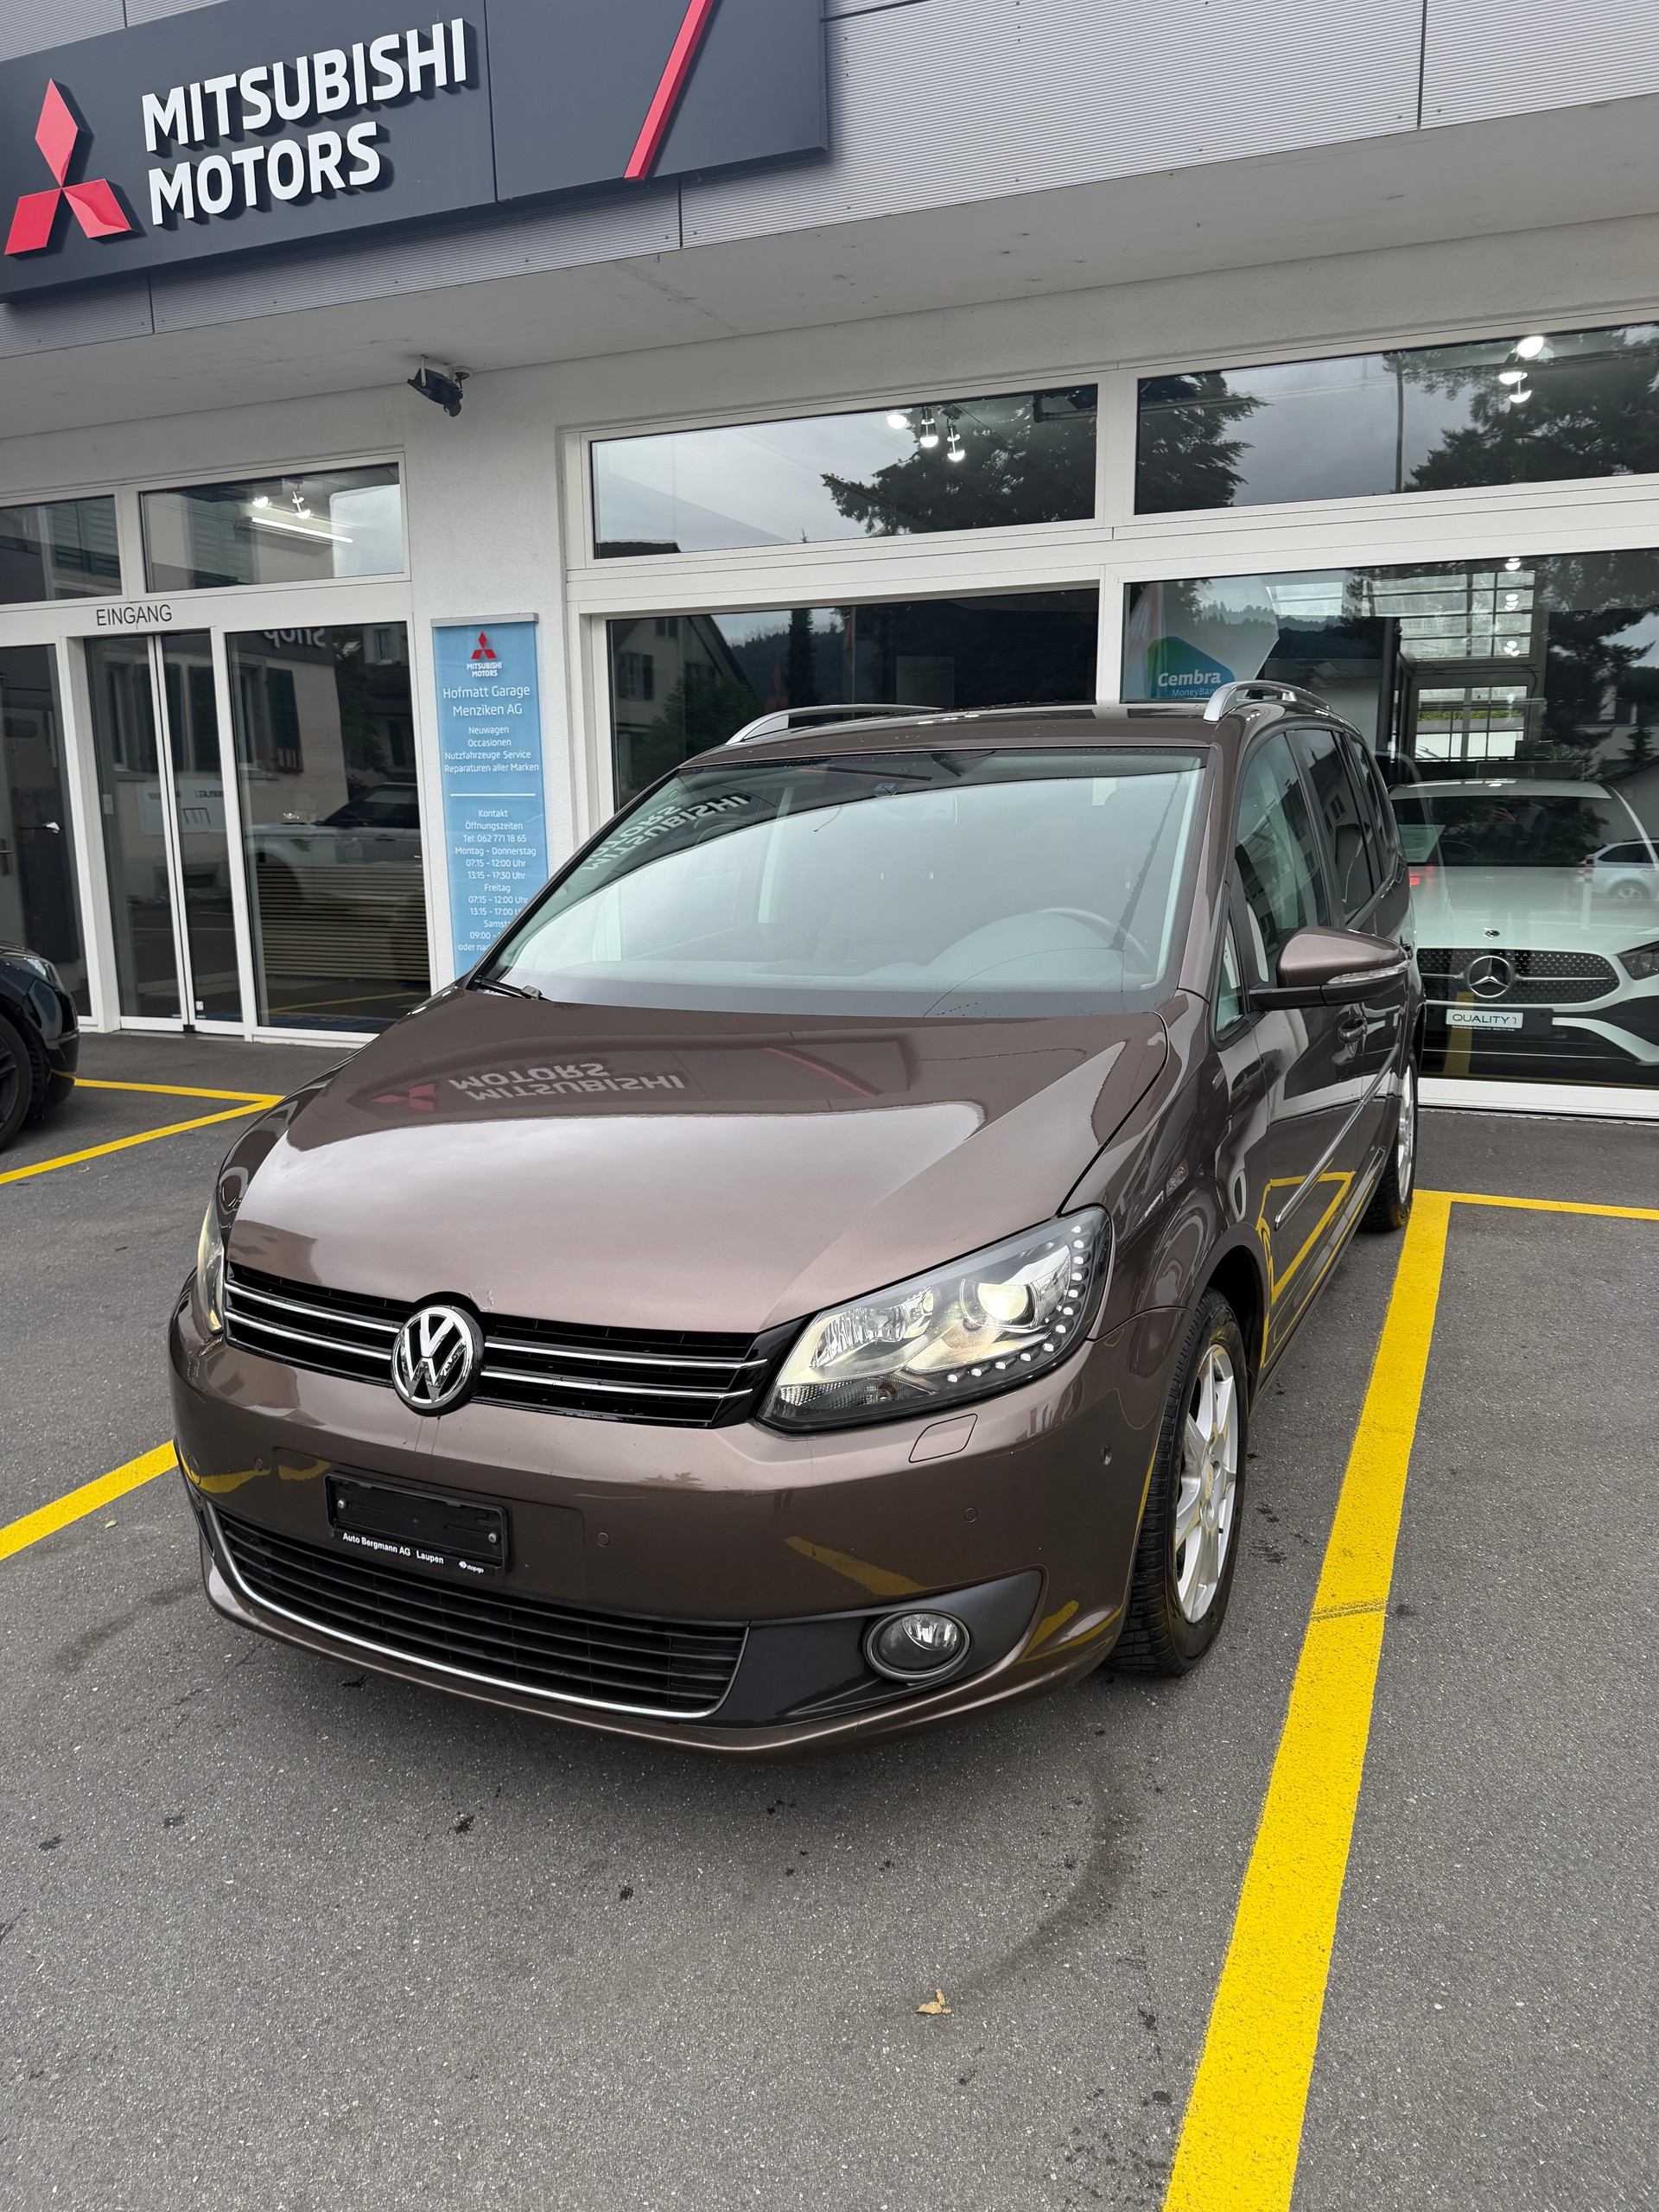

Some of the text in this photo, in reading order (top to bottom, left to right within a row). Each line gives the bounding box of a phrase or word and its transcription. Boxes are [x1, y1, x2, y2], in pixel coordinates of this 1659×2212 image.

[142, 17, 467, 153] MITSUBISHI
[148, 121, 381, 226] MOTORS
[96, 604, 172, 626] EINGANG
[1158, 669, 1222, 687] Cembra
[443, 685, 530, 699] Hofmatt Garage
[1172, 687, 1217, 698] MoneyBan
[453, 702, 522, 716] Menziken AG
[468, 727, 509, 735] Neuwagen
[467, 738, 512, 747] Occasionen
[445, 750, 531, 760] Nutzfahrzeuge Service
[444, 764, 491, 773] Reparaturen
[493, 763, 509, 772] aller
[465, 820, 523, 831] Öffnungszeiten
[477, 834, 492, 842] 062
[493, 834, 505, 842] 771
[507, 834, 515, 842] 18
[517, 834, 527, 842] 65
[454, 847, 484, 857] Montag
[492, 847, 537, 857] Donnerstag
[492, 859, 511, 868] 12:00
[512, 859, 526, 868] Uhr
[467, 871, 485, 880] 13:15
[493, 871, 511, 880] 17:30
[512, 871, 526, 880] Uhr
[484, 884, 511, 893] Freitag
[468, 895, 486, 904] 07:15
[493, 895, 513, 904] 12:00
[470, 907, 487, 916] 13:15
[494, 907, 513, 916] 17:00
[484, 919, 510, 928] Samst
[1452, 1014, 1517, 1025] QUALITY 1
[397, 1307, 471, 1404] VW
[342, 1532, 444, 1565] Auto Bergmann AG Laupen
